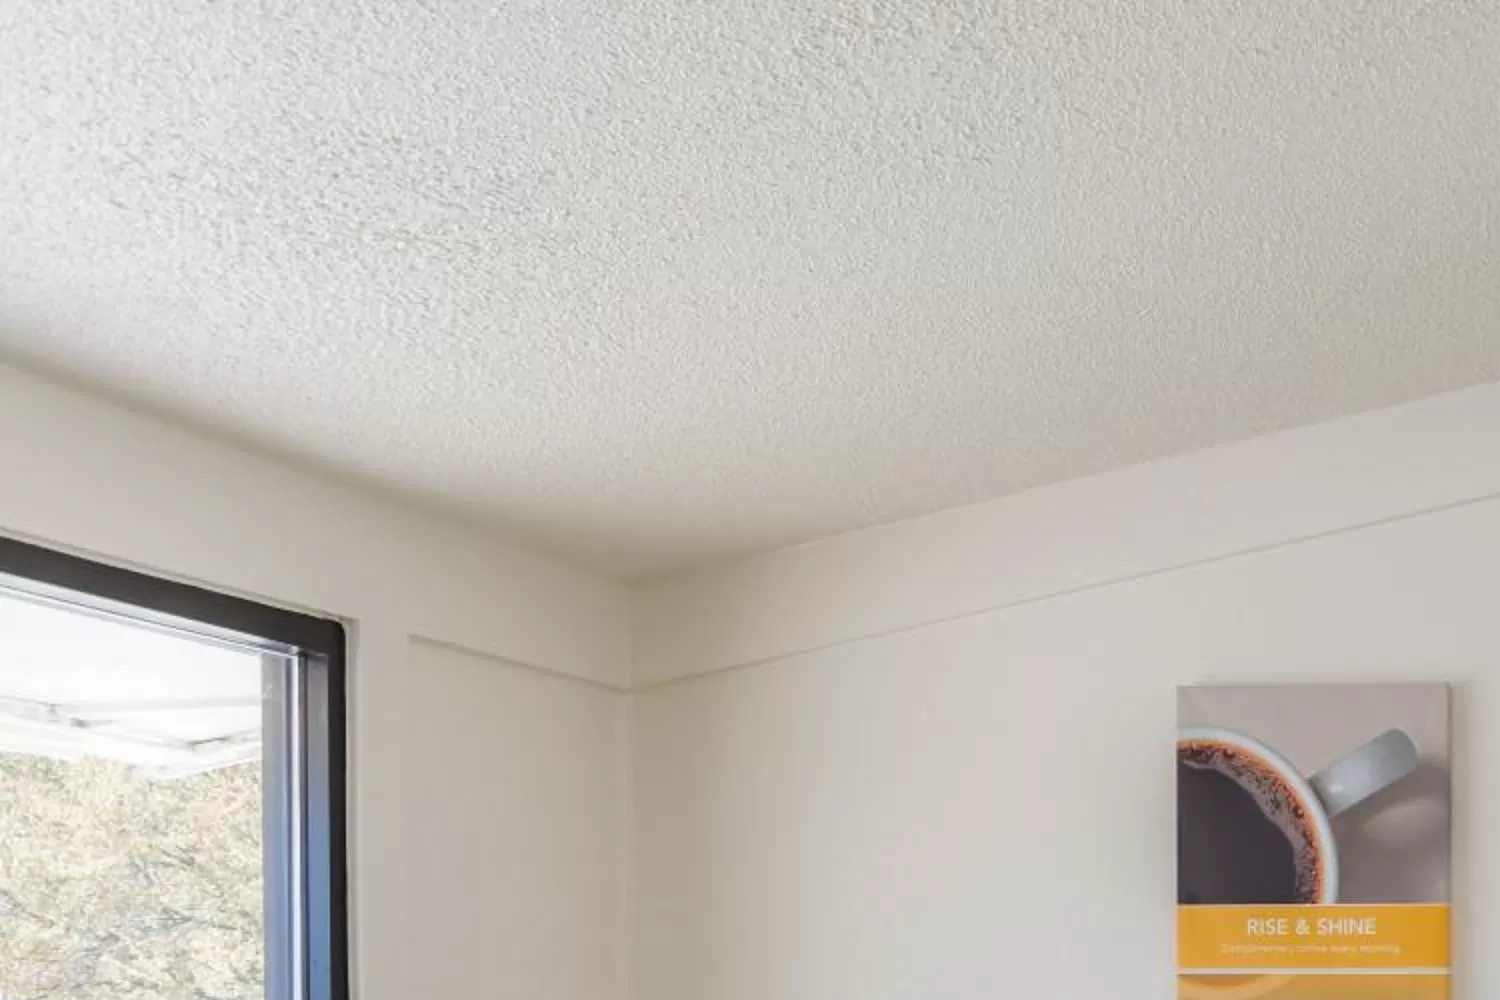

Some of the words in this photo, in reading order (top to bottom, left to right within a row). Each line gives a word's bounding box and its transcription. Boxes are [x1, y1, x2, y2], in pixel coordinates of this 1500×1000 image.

[1247, 917, 1288, 935] RISE
[1295, 917, 1310, 935] &
[1316, 917, 1377, 935] SHINE
